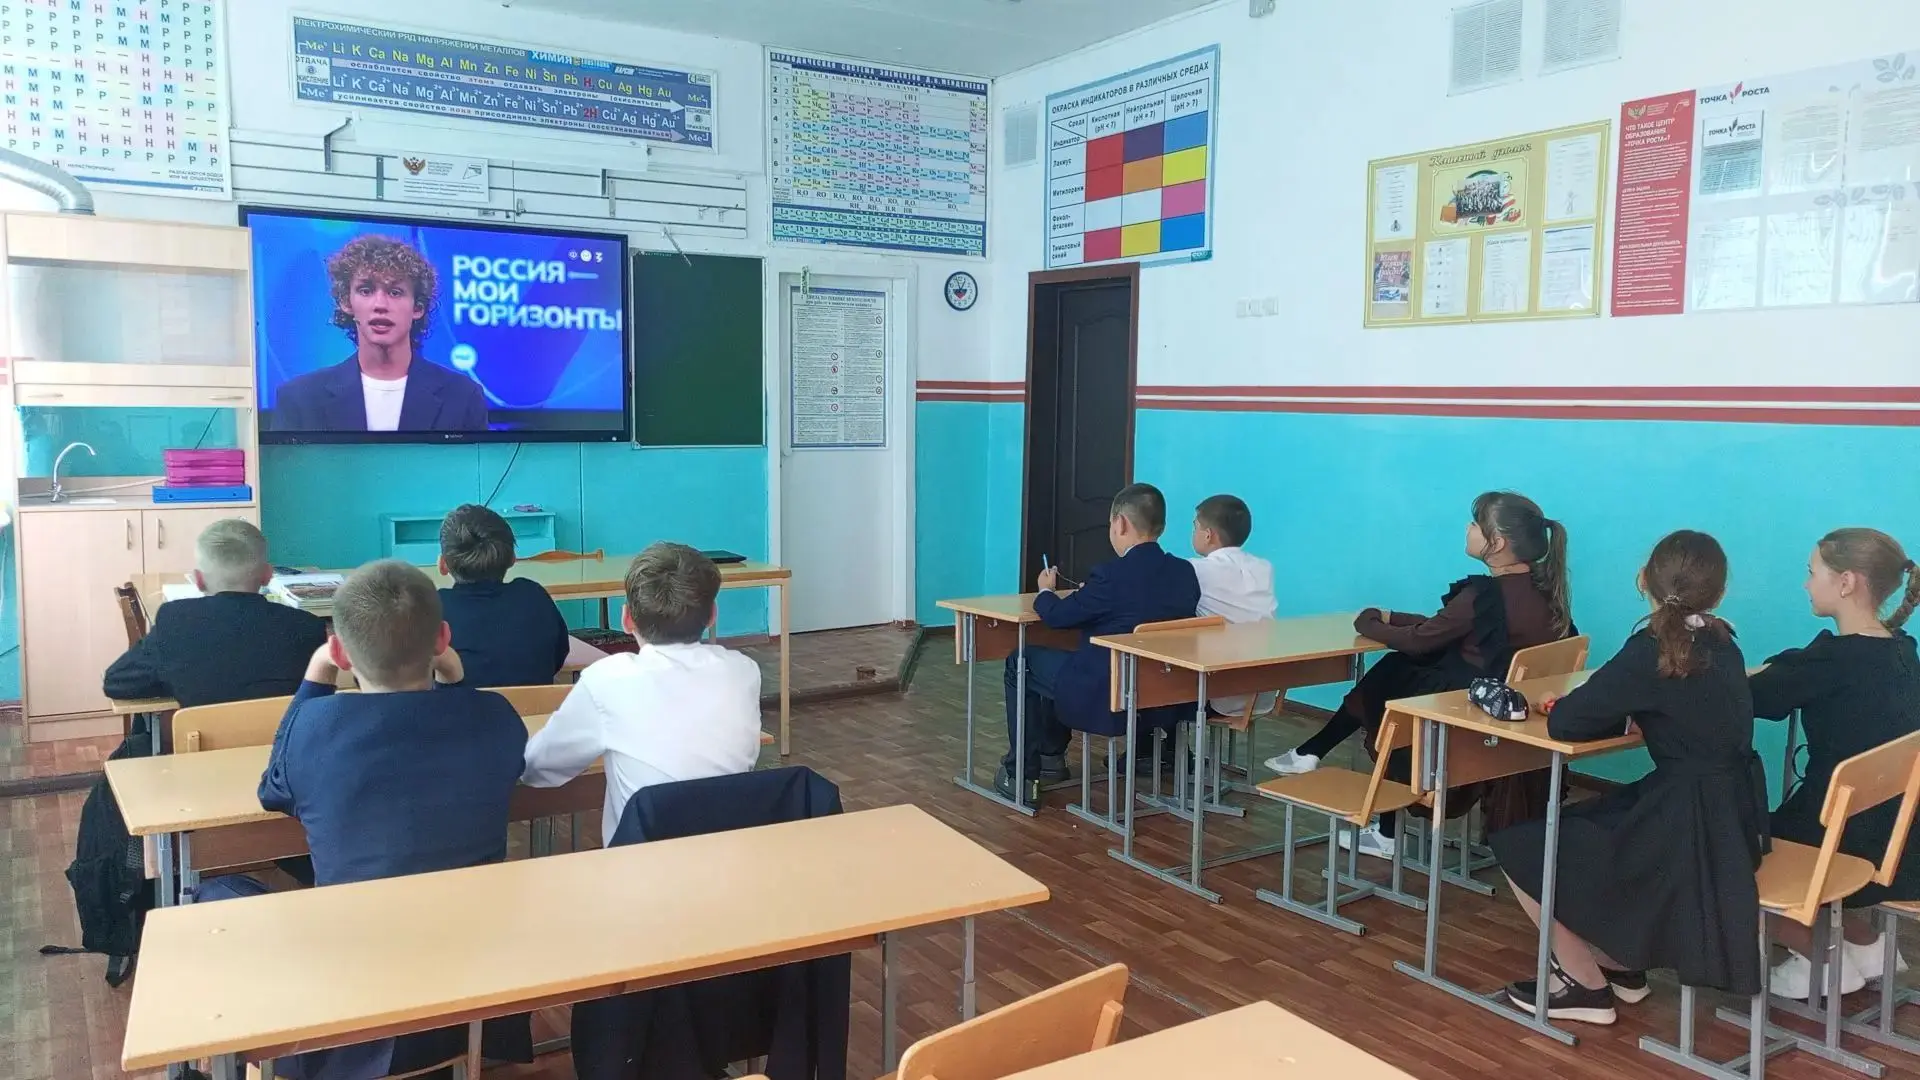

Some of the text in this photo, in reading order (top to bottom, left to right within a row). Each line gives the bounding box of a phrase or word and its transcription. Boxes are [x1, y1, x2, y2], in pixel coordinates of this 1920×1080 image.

[399, 33, 416, 41] РЯД
[480, 45, 525, 57] МЕТАЛЛОВ
[532, 51, 572, 65] ХИМИЯ
[332, 42, 344, 54] Li
[352, 44, 361, 57] K
[368, 47, 386, 59] Ca
[392, 49, 409, 62] Na
[416, 53, 434, 68] Mg
[440, 57, 453, 68] Al
[460, 59, 477, 72] Mn
[484, 62, 498, 75] Zn
[505, 65, 519, 77] Fe
[525, 68, 536, 80] Ni
[543, 71, 557, 83] Sn
[564, 74, 578, 85] Pb
[598, 79, 613, 90] Cu
[618, 82, 632, 94] Ag
[638, 85, 652, 98] Hg
[657, 87, 672, 98] Au
[350, 62, 412, 75] ослабляется
[418, 71, 461, 81] свойство
[503, 82, 543, 92] отдавать
[554, 88, 599, 99] электроны
[1052, 61, 1209, 114] ОКРАСКА ИНДИКАТОРОВ В РАЗЛИЧНЫХ СРЕДАХ
[1170, 88, 1203, 102] Щелочная
[1700, 87, 1770, 104] ТОЧКА РОСТА
[337, 93, 399, 106] усиливается
[403, 101, 446, 112] свойство
[540, 117, 585, 128] электроны
[1126, 99, 1164, 114] Нейтральная
[1068, 118, 1085, 128] Среда
[1091, 110, 1120, 123] Кислотная
[1708, 123, 1756, 136] ТОЧКА РОСТА
[1053, 136, 1080, 147] Индикатор
[1052, 158, 1072, 167] Лакмус
[1052, 241, 1081, 252] Тимоловый
[453, 280, 519, 303] МОИ
[453, 303, 622, 331] ГОРИЗОНТЫ
